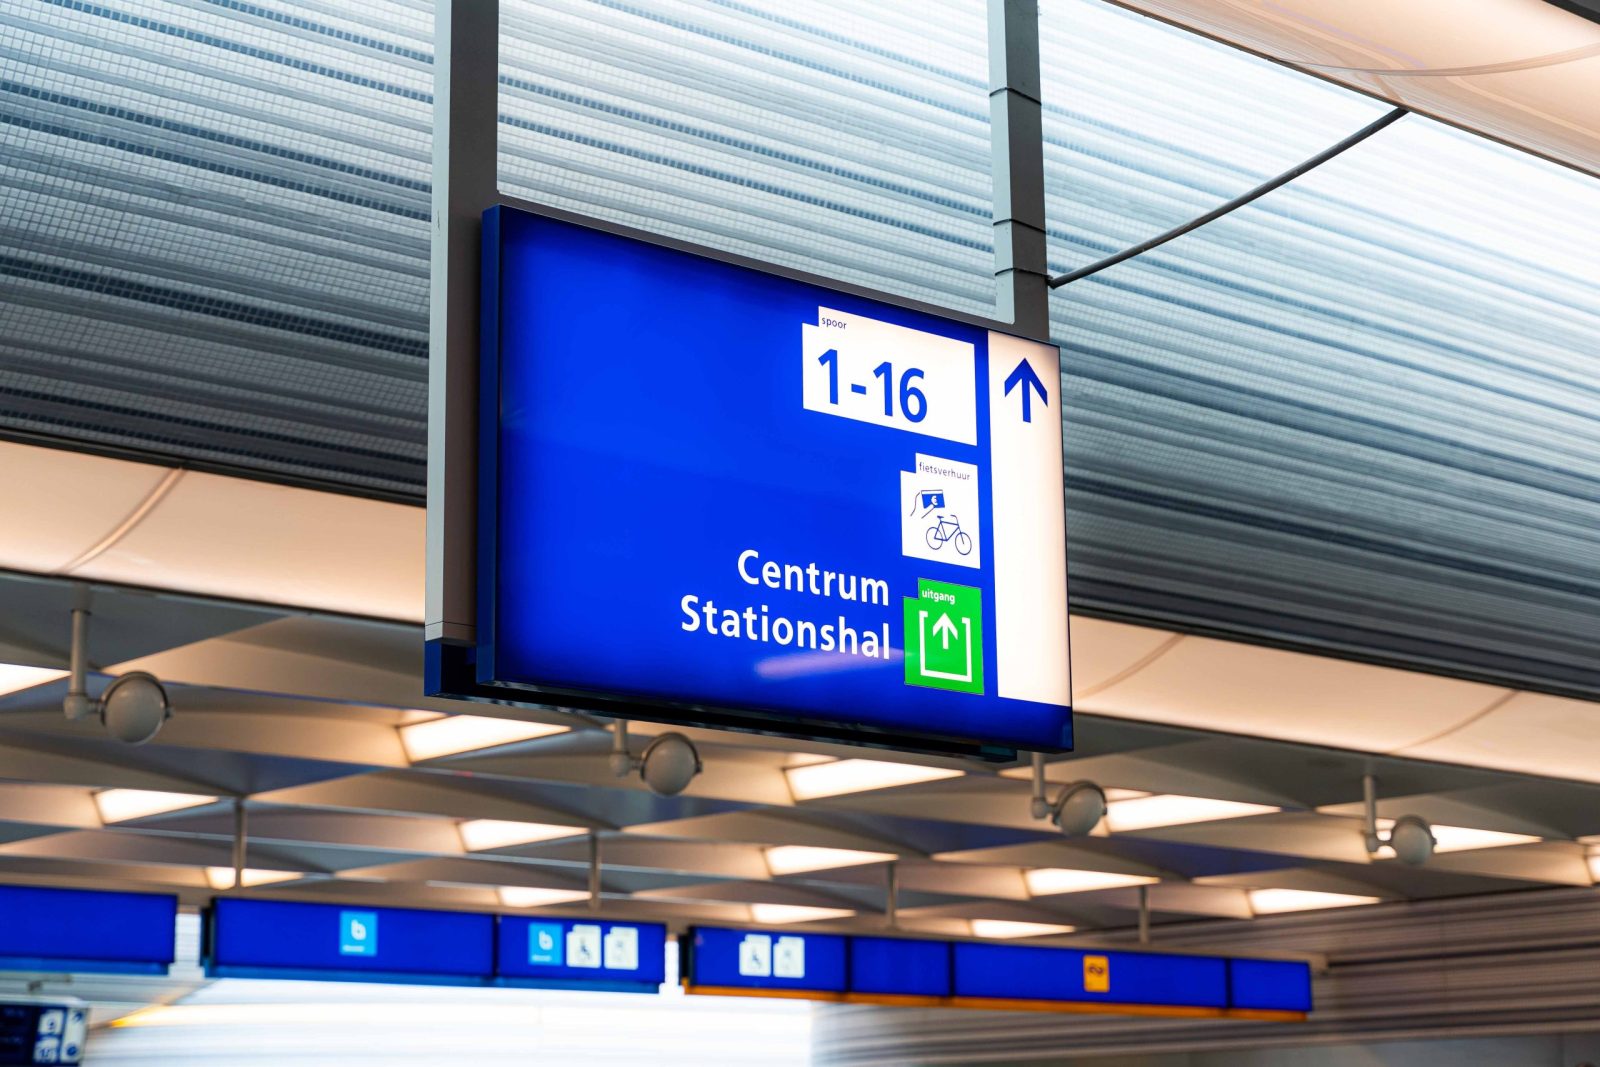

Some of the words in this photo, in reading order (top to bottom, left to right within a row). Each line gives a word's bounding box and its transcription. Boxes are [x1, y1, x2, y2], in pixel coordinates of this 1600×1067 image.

[821, 317, 847, 330] spoor
[818, 348, 928, 423] 1-16
[919, 462, 971, 480] fietsverhuur
[737, 549, 889, 606] Centrum
[922, 588, 956, 605] uitgang
[681, 595, 889, 660] Stationshal
